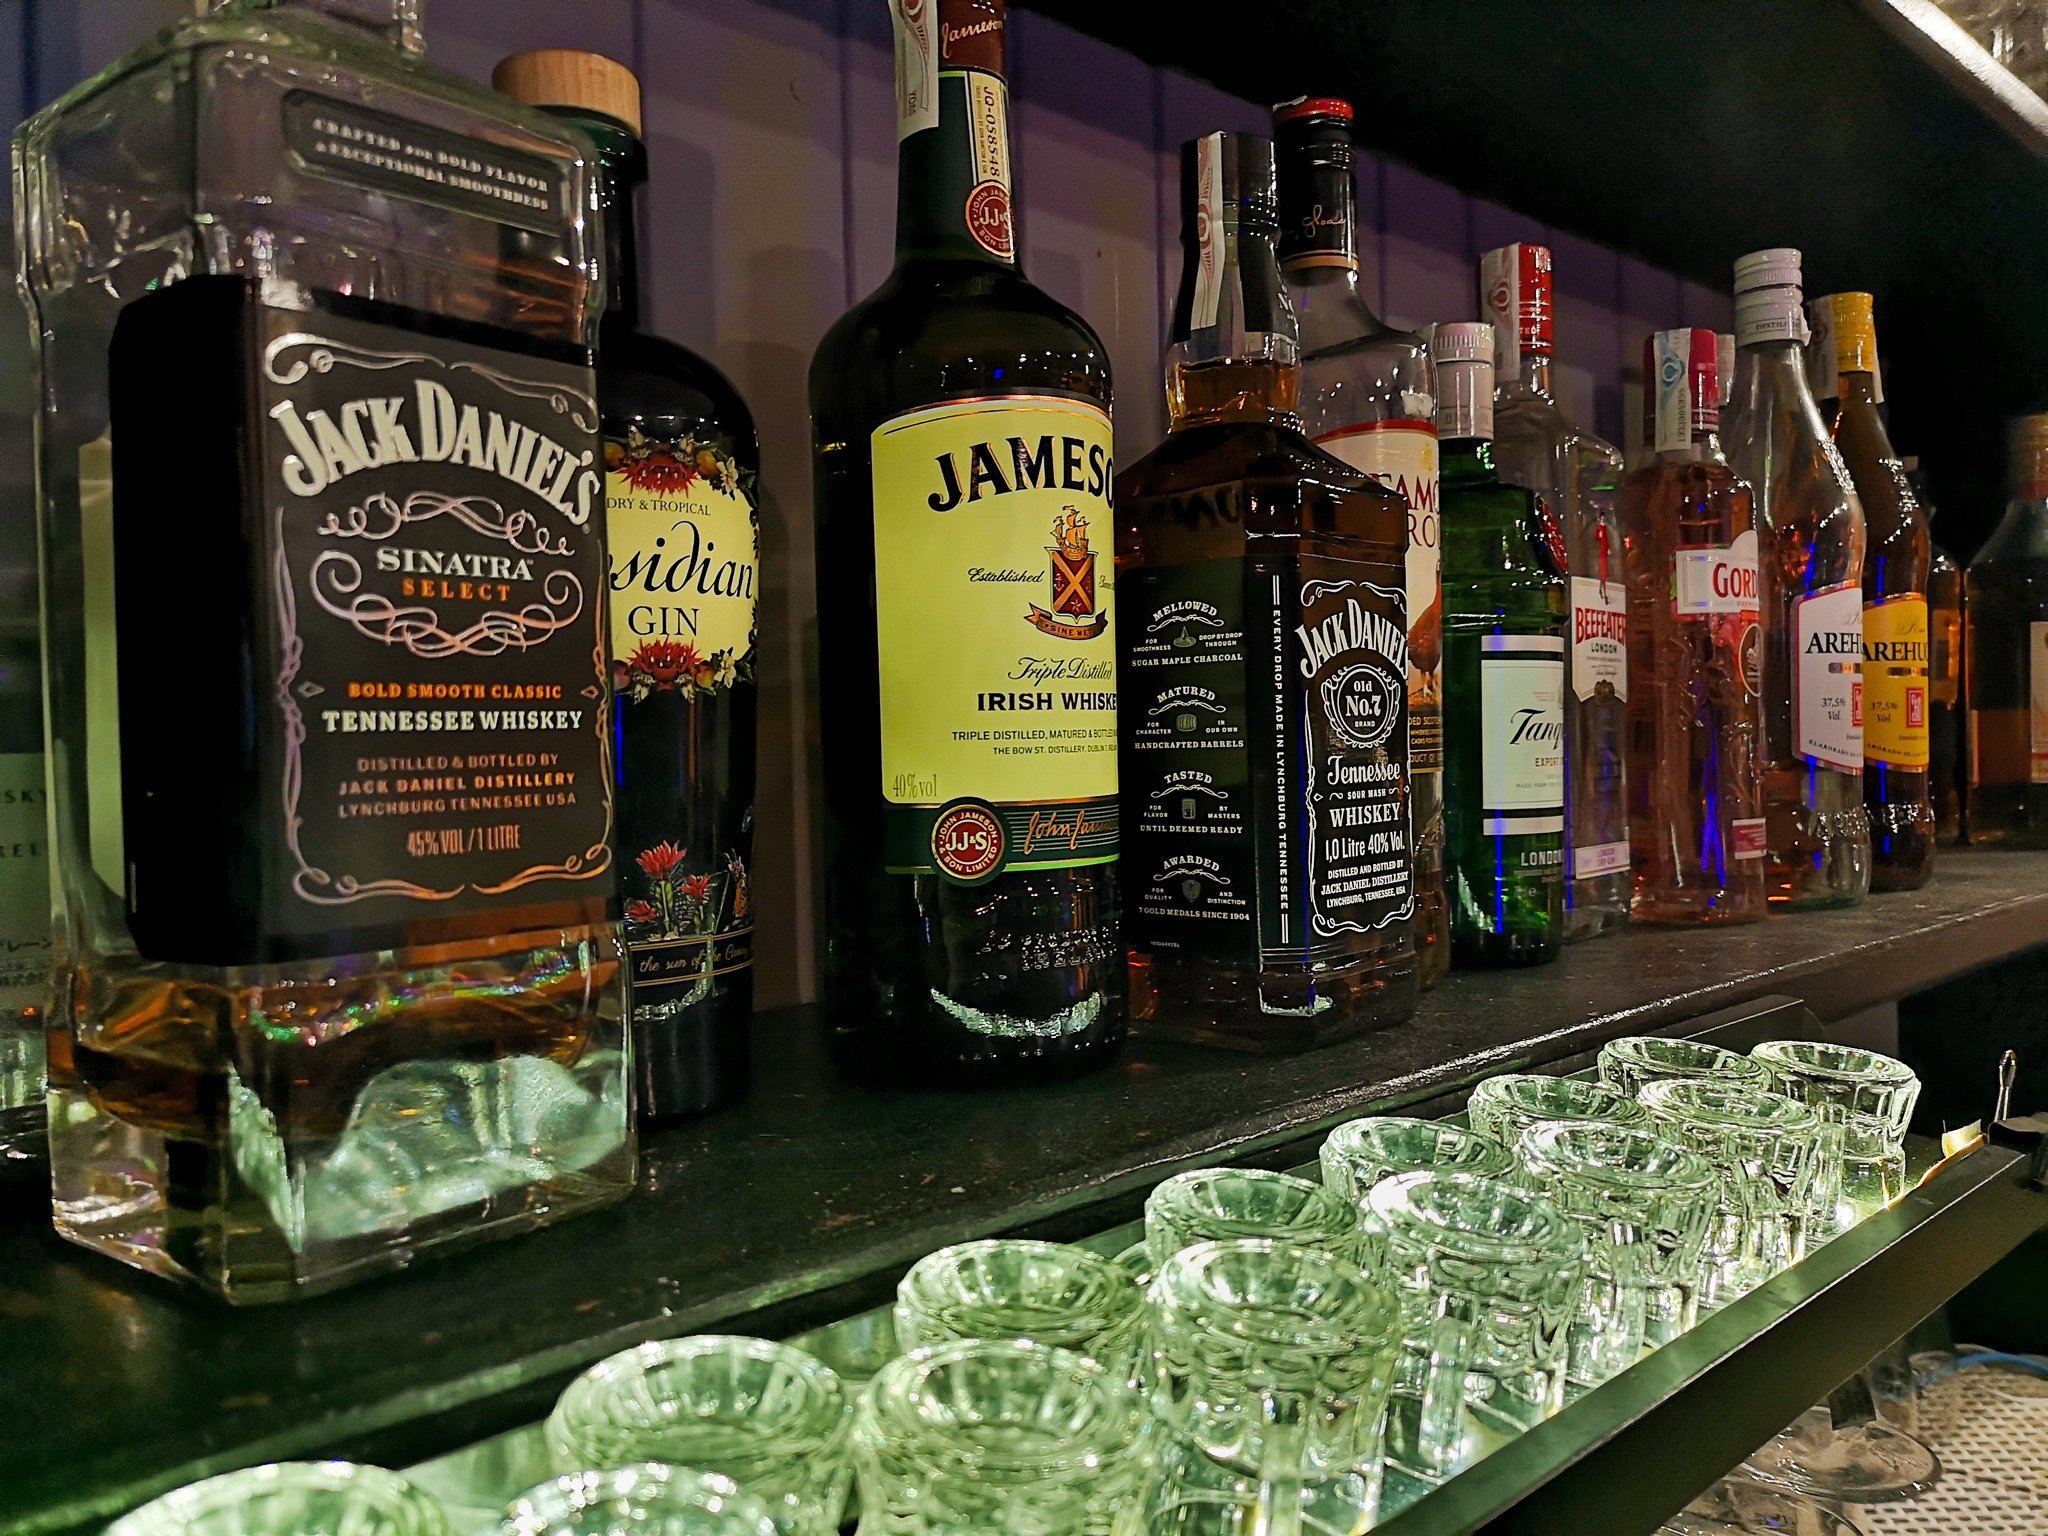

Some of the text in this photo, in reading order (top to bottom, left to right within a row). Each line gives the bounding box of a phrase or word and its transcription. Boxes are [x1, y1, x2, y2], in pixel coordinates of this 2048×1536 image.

[437, 151, 483, 173] BOLD
[485, 164, 548, 192] FLAVOR
[449, 173, 549, 210] SMOOTHNESS
[972, 190, 988, 214] JOHN
[268, 378, 601, 526] JACK DANIEL'S
[607, 498, 712, 517] DRY & TROPICAL
[376, 545, 534, 582] SINATRA
[967, 567, 1046, 584] Established
[402, 578, 511, 602] SELECT
[628, 605, 700, 637] GIN
[1153, 601, 1218, 622] MELLOWED
[1050, 624, 1074, 636] SINE
[1133, 644, 1171, 653] SMOOTHNESS
[1205, 640, 1237, 648] THROUGH
[1294, 611, 1350, 679] JACK
[1591, 642, 1618, 654] LONDON
[1132, 653, 1244, 667] SUGAR MAPLE CHARCOAL
[1008, 656, 1066, 686] Triple
[348, 682, 562, 700] BOLD SMOOTH CLASSIC
[1157, 686, 1216, 704] MATURED
[1353, 680, 1373, 692] Old
[977, 692, 1053, 711] IRISH
[1345, 695, 1382, 717] No.7
[321, 710, 583, 733] TENNESSEE WHISKEY
[1354, 720, 1376, 728] BRAND
[952, 731, 990, 741] TRIPLE
[993, 730, 1047, 741] DISTILLED,
[1049, 729, 1088, 739] MATURED
[1135, 740, 1244, 749] HANDCRAFTED BARRELS
[993, 745, 1086, 755] THE BOW ST. DISTILLERY,
[1273, 609, 1289, 910] EVERY DROP MADE IN LYNCHBURG TENNESSEE
[357, 753, 560, 772] DISTILLED & BOTTLED BY
[1327, 755, 1401, 785] Tennessee
[339, 772, 575, 796] JACK DANIEL DISTILLERY
[892, 774, 937, 798] 40% vol
[1163, 770, 1213, 785] TASTED
[1347, 788, 1386, 800] SOUR MASH
[339, 792, 577, 818] LYNCHBURG TENNESSEE USA
[1328, 802, 1401, 828] WHISKEY
[939, 811, 999, 840] JOHN JAMESON
[1023, 811, 1070, 855] John
[1169, 825, 1208, 833] DEEMED
[1210, 826, 1243, 834] READY
[945, 831, 988, 851] JJ&S
[1342, 835, 1366, 859] Litre
[1367, 831, 1389, 856] 40%
[1390, 830, 1406, 851] Vol.
[943, 855, 963, 871] SON
[966, 846, 998, 873] LIMITED
[1163, 855, 1220, 872] AWARDED
[1328, 859, 1404, 880] DISTILLED AND BOTTLED BY
[1320, 871, 1409, 896] JACK DANIEL DISTILLERY
[1207, 898, 1246, 906] DISTINCTION
[1326, 885, 1406, 908] LYNCHBURG, TENNESSEE, USA
[1143, 907, 1166, 915] GOLD
[1166, 908, 1200, 917] MEDALS
[1202, 910, 1228, 919] SINCE
[1230, 913, 1250, 921] 1904
[640, 955, 660, 973] the
